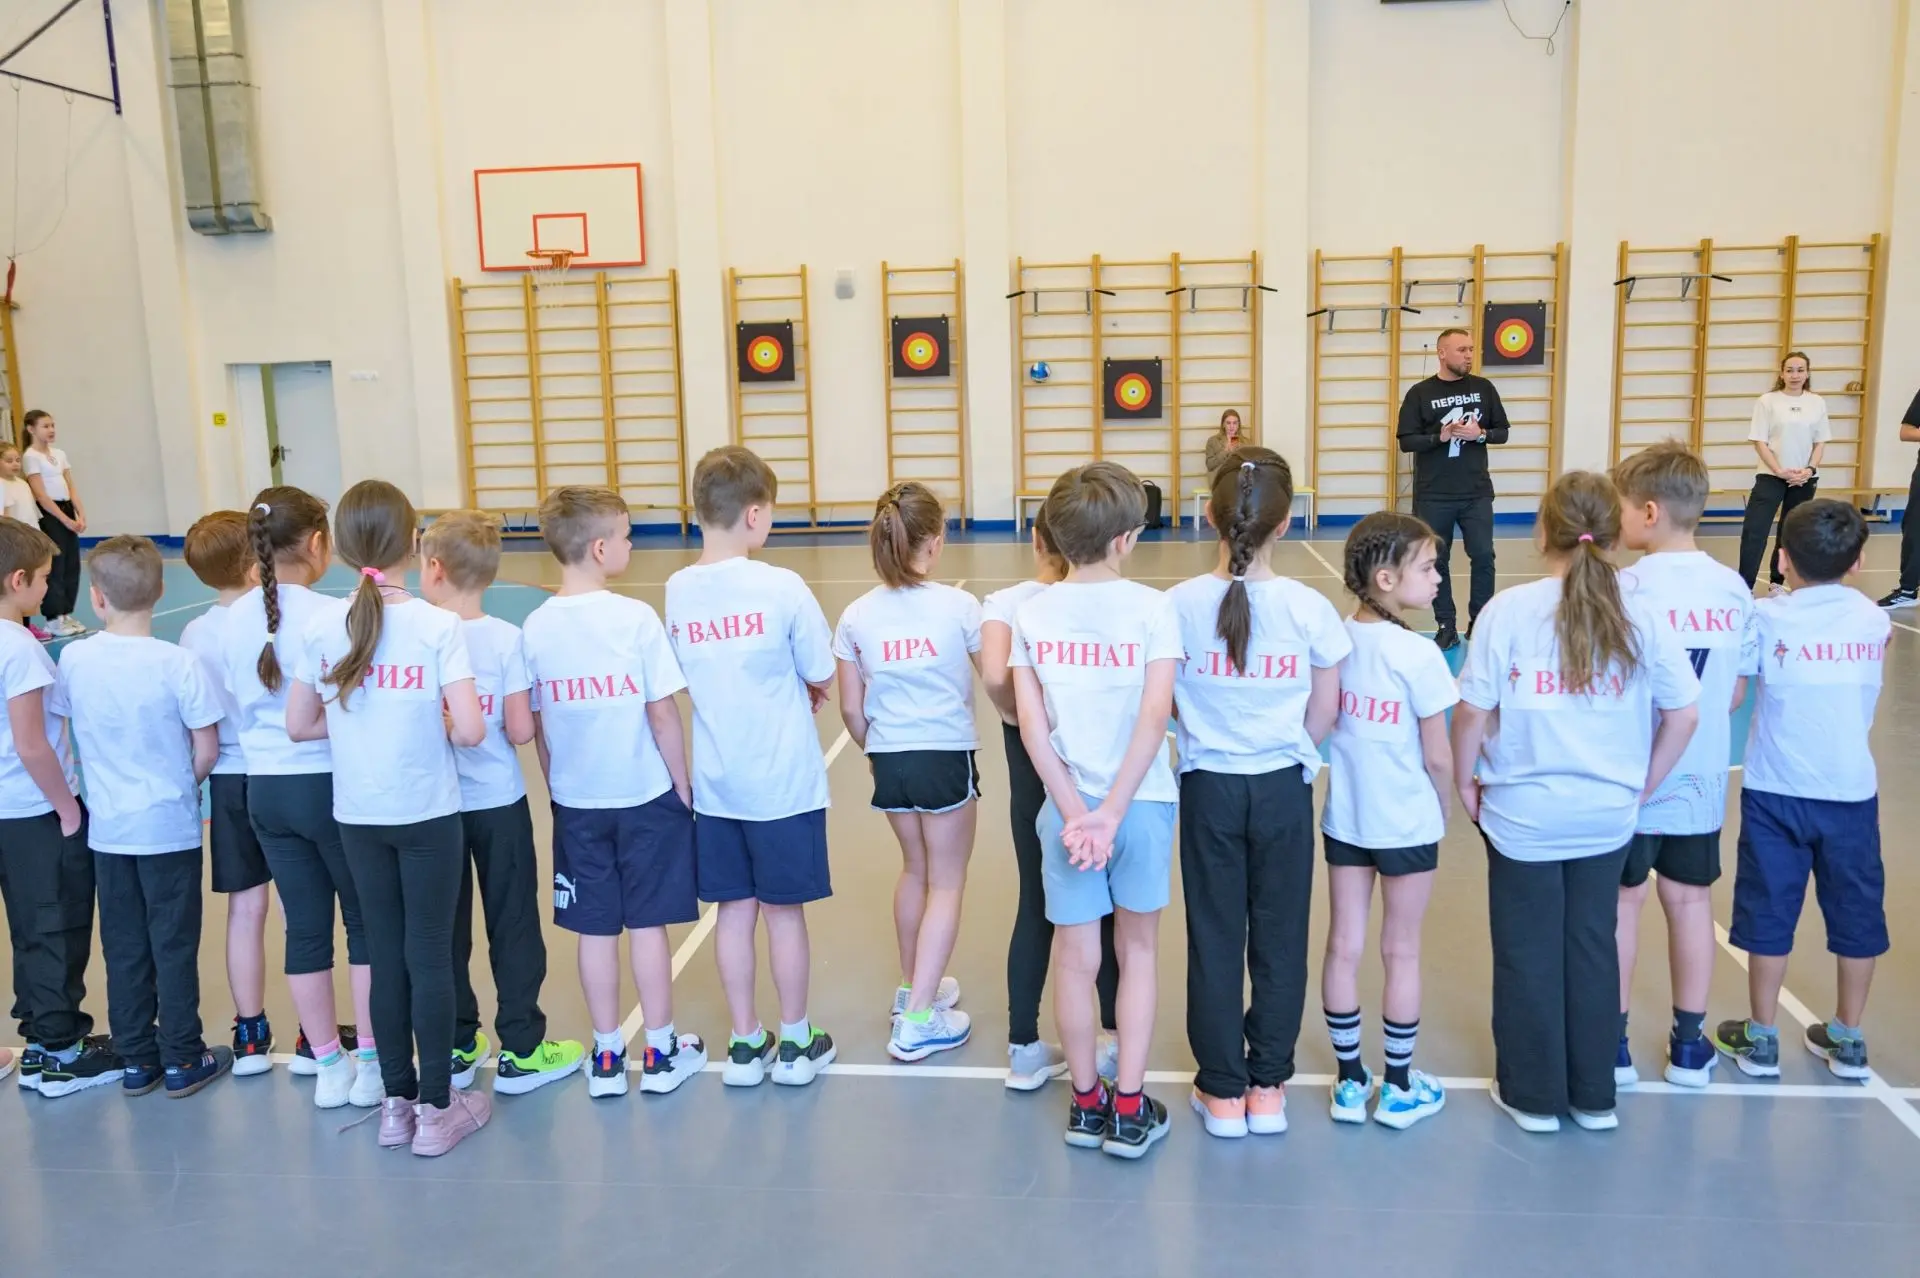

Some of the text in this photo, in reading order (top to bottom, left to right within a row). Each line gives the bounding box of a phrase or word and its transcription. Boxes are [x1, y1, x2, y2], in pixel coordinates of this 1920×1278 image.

[1431, 392, 1482, 409] ПЕРВЫЕ
[686, 611, 765, 645] ВАНЯ
[880, 637, 938, 663] ИРА
[1036, 640, 1141, 668] РИНАТ
[545, 673, 641, 703] ТИМА
